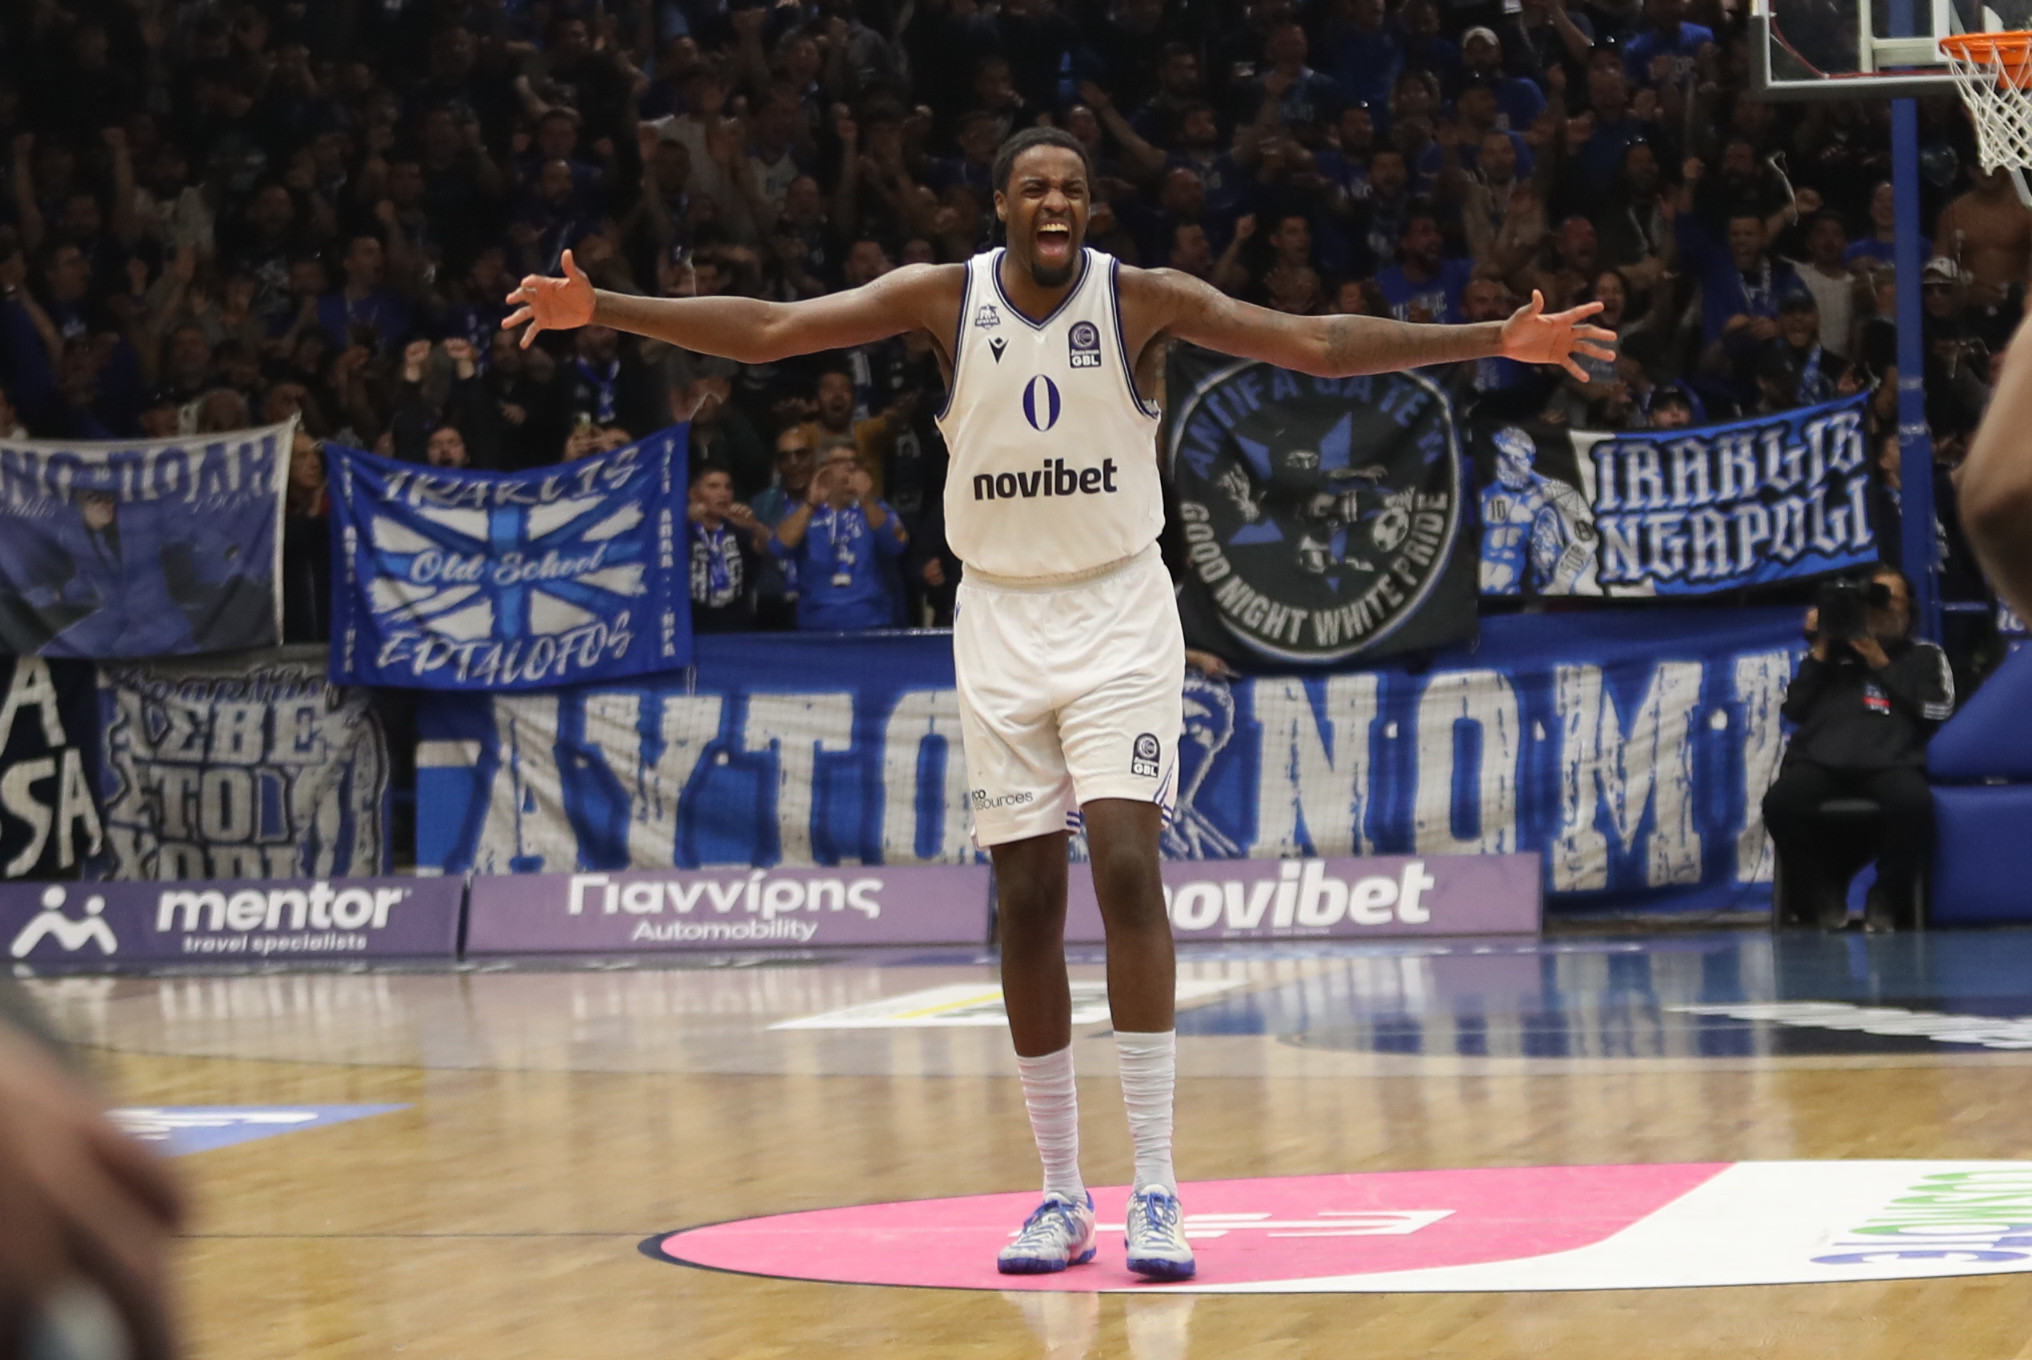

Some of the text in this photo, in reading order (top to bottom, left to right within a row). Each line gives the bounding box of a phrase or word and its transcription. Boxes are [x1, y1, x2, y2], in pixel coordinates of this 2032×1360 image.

[1072, 354, 1100, 367] GBL
[1022, 374, 1061, 432] 0
[1182, 368, 1299, 481] ANTIFA
[973, 458, 1118, 500] novibet
[409, 543, 608, 586] Old School
[1180, 491, 1449, 648] GOOD NIGHT WHITE PRIDE
[1133, 763, 1158, 777] GBL
[156, 881, 404, 932] mentor
[567, 871, 884, 918] Γιαννίρης
[1163, 859, 1435, 930] ovibet
[182, 934, 368, 957] travel specialists
[632, 918, 818, 942] Automobility
